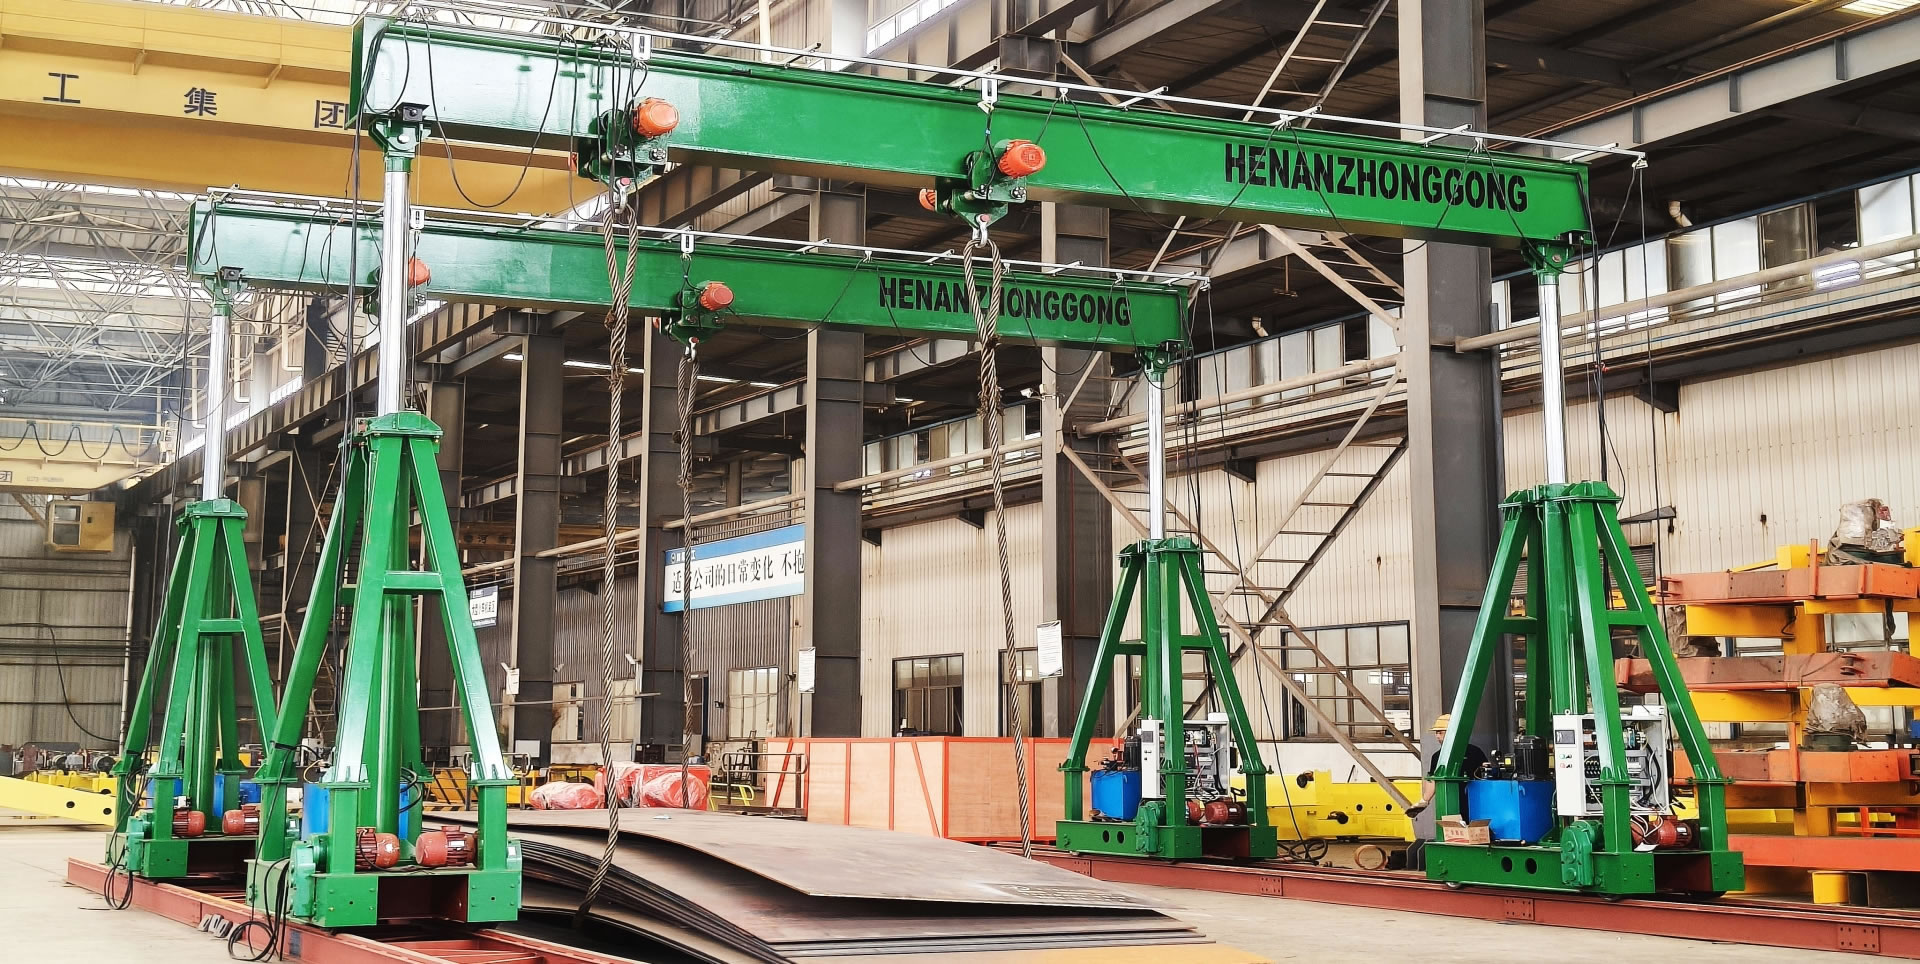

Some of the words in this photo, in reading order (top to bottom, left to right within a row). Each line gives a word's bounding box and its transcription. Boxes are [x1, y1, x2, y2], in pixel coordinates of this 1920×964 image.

[1224, 142, 1528, 213] HENANZHONGGONG
[672, 554, 774, 594] 适公司的日常变化
